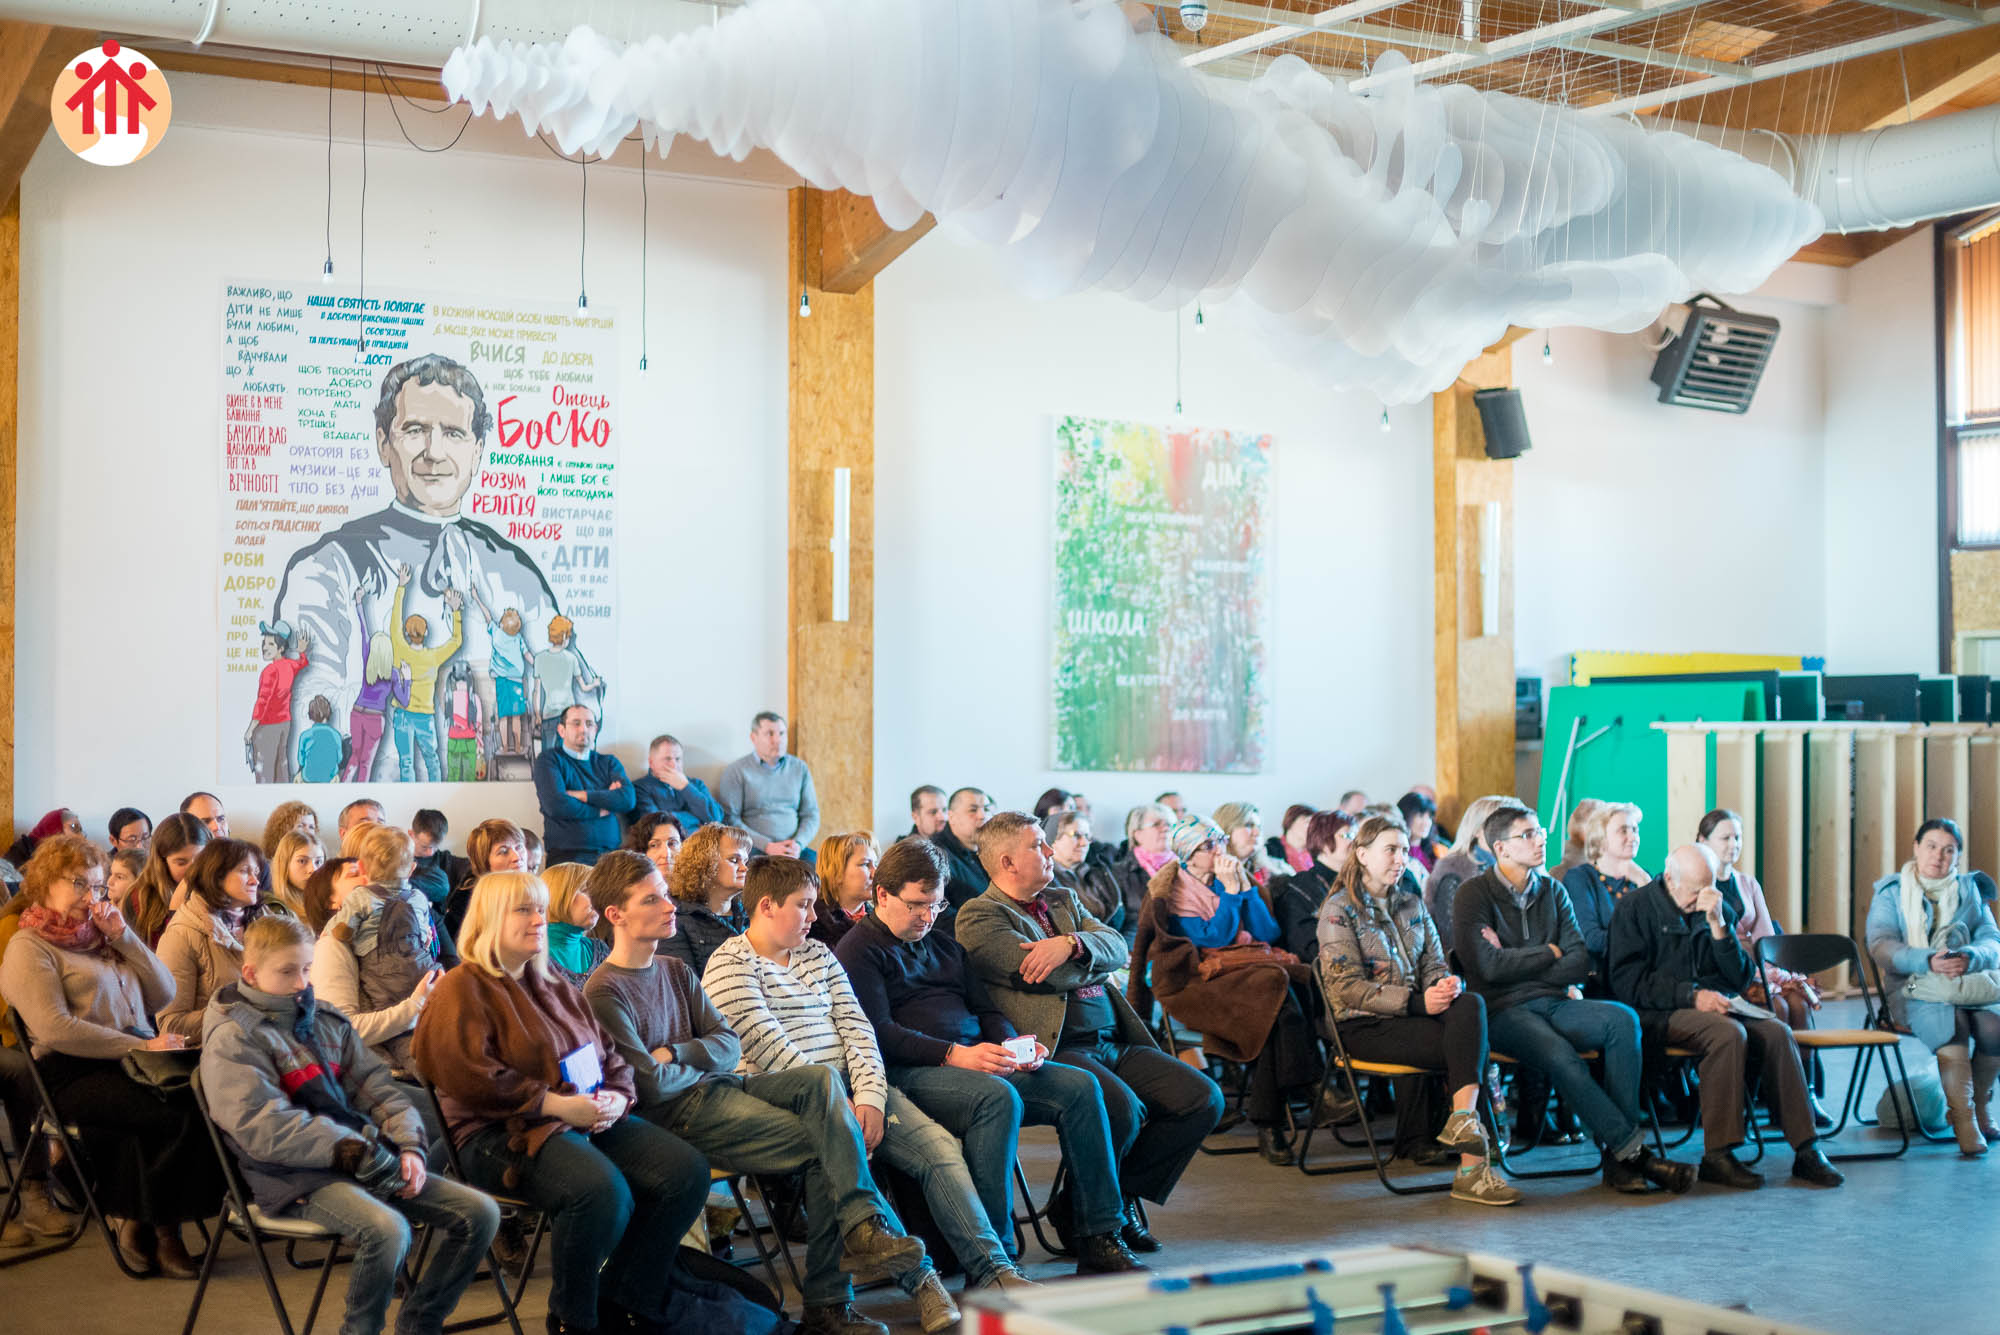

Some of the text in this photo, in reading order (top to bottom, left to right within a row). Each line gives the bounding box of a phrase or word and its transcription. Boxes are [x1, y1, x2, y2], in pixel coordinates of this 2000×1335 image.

[277, 290, 293, 302] ЩО
[226, 303, 303, 318] ДІТИ НЕ ЛИШЕ
[307, 295, 425, 314] НАША СВЯТІСТЬ ПОЛЯГАЄ
[327, 312, 360, 321] ДОБРОМУ
[362, 314, 400, 325] ВИКОНАННІ
[400, 316, 424, 326] НАШИХ
[226, 319, 298, 335] БУЛИ ЛЮБИМІ,
[226, 335, 259, 347] А ЩОБ
[309, 336, 316, 344] ТА
[470, 340, 525, 364] ВЧИСЯ
[542, 351, 594, 367] ДО ДОБРА
[226, 365, 254, 378] ЩО Ж
[298, 365, 372, 377] ЩОБ ТВОРИТИ
[503, 368, 593, 384] ЩОБ ТЕБЕ ЛЮБИЛИ
[329, 378, 372, 389] ДОБРО
[298, 388, 352, 398] ПОТРІБНО
[257, 396, 262, 408] В
[264, 396, 282, 410] МЕНЕ
[334, 400, 361, 409] МАТИ
[298, 408, 337, 419] ХОЧА Б
[298, 419, 335, 428] ТРІШКИ
[227, 424, 287, 444] БАЧИТИ ВАС
[323, 431, 370, 440] ВІДВАГИ
[227, 442, 271, 456] ЩАСЛИВИМИ
[289, 446, 369, 460] ОРАТОРІЯ БЕЗ
[242, 457, 249, 470] ТА
[490, 452, 554, 467] ВИХОВАННЯ
[290, 464, 336, 477] МУЗИКИ
[346, 467, 360, 480] ЦЕ
[368, 467, 381, 479] ЯК
[229, 472, 279, 493] ВІЧНОСТІ
[481, 470, 526, 490] РОЗУМ
[550, 473, 575, 484] ЛИШЕ
[581, 474, 598, 485] БОГ
[602, 475, 609, 486] Є
[288, 482, 379, 500] ТІЛО БЕЗ ДУШІ
[537, 486, 613, 501] ЙОГО ГОСПОДАРЕМ
[299, 504, 315, 514] ЩО
[473, 492, 536, 517] РЕЛІГІЯ
[542, 507, 613, 521] ВИСТАРЧАЄ
[272, 519, 321, 533] РАДІСНИХ
[507, 521, 563, 541] ЛЮБОВ
[576, 526, 613, 538] ЩО ВИ
[235, 535, 265, 546] ЛЮДЕЙ
[224, 552, 264, 567] РОБИ
[552, 545, 609, 571] ДІТИ
[224, 576, 276, 592] ДОБРО
[552, 574, 608, 584] ЩОБ Я ВАС
[566, 589, 595, 599] ДУЖЕ
[566, 605, 612, 618] ЛЮБИВ
[231, 616, 256, 627] ЩОБ
[1067, 610, 1146, 637] ШКОЛА
[227, 631, 248, 641] ПРО
[226, 648, 259, 659] ЦЕ НЕ
[227, 663, 258, 673] ЗНАЛИ
